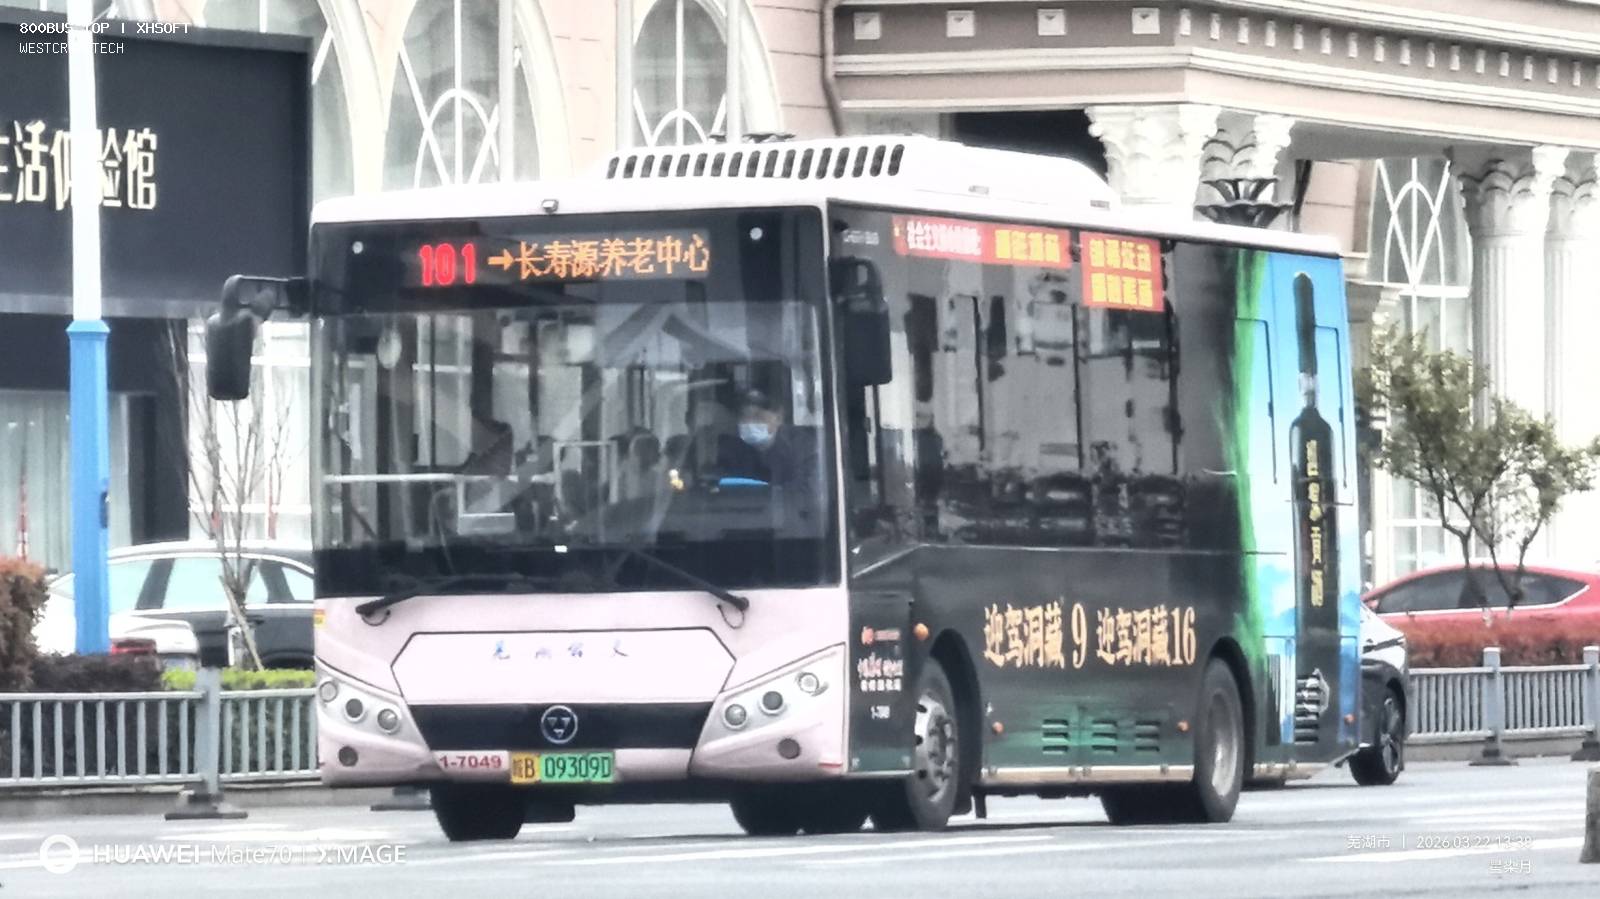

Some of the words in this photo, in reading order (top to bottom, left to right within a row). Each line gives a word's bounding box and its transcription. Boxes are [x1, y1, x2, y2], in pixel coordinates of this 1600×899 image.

[419, 243, 476, 286] 101
[515, 234, 710, 280] 长寿源养老中心
[984, 600, 1065, 669] 迎驾洞藏
[1071, 602, 1088, 669] 9
[439, 755, 502, 769] 1-7049
